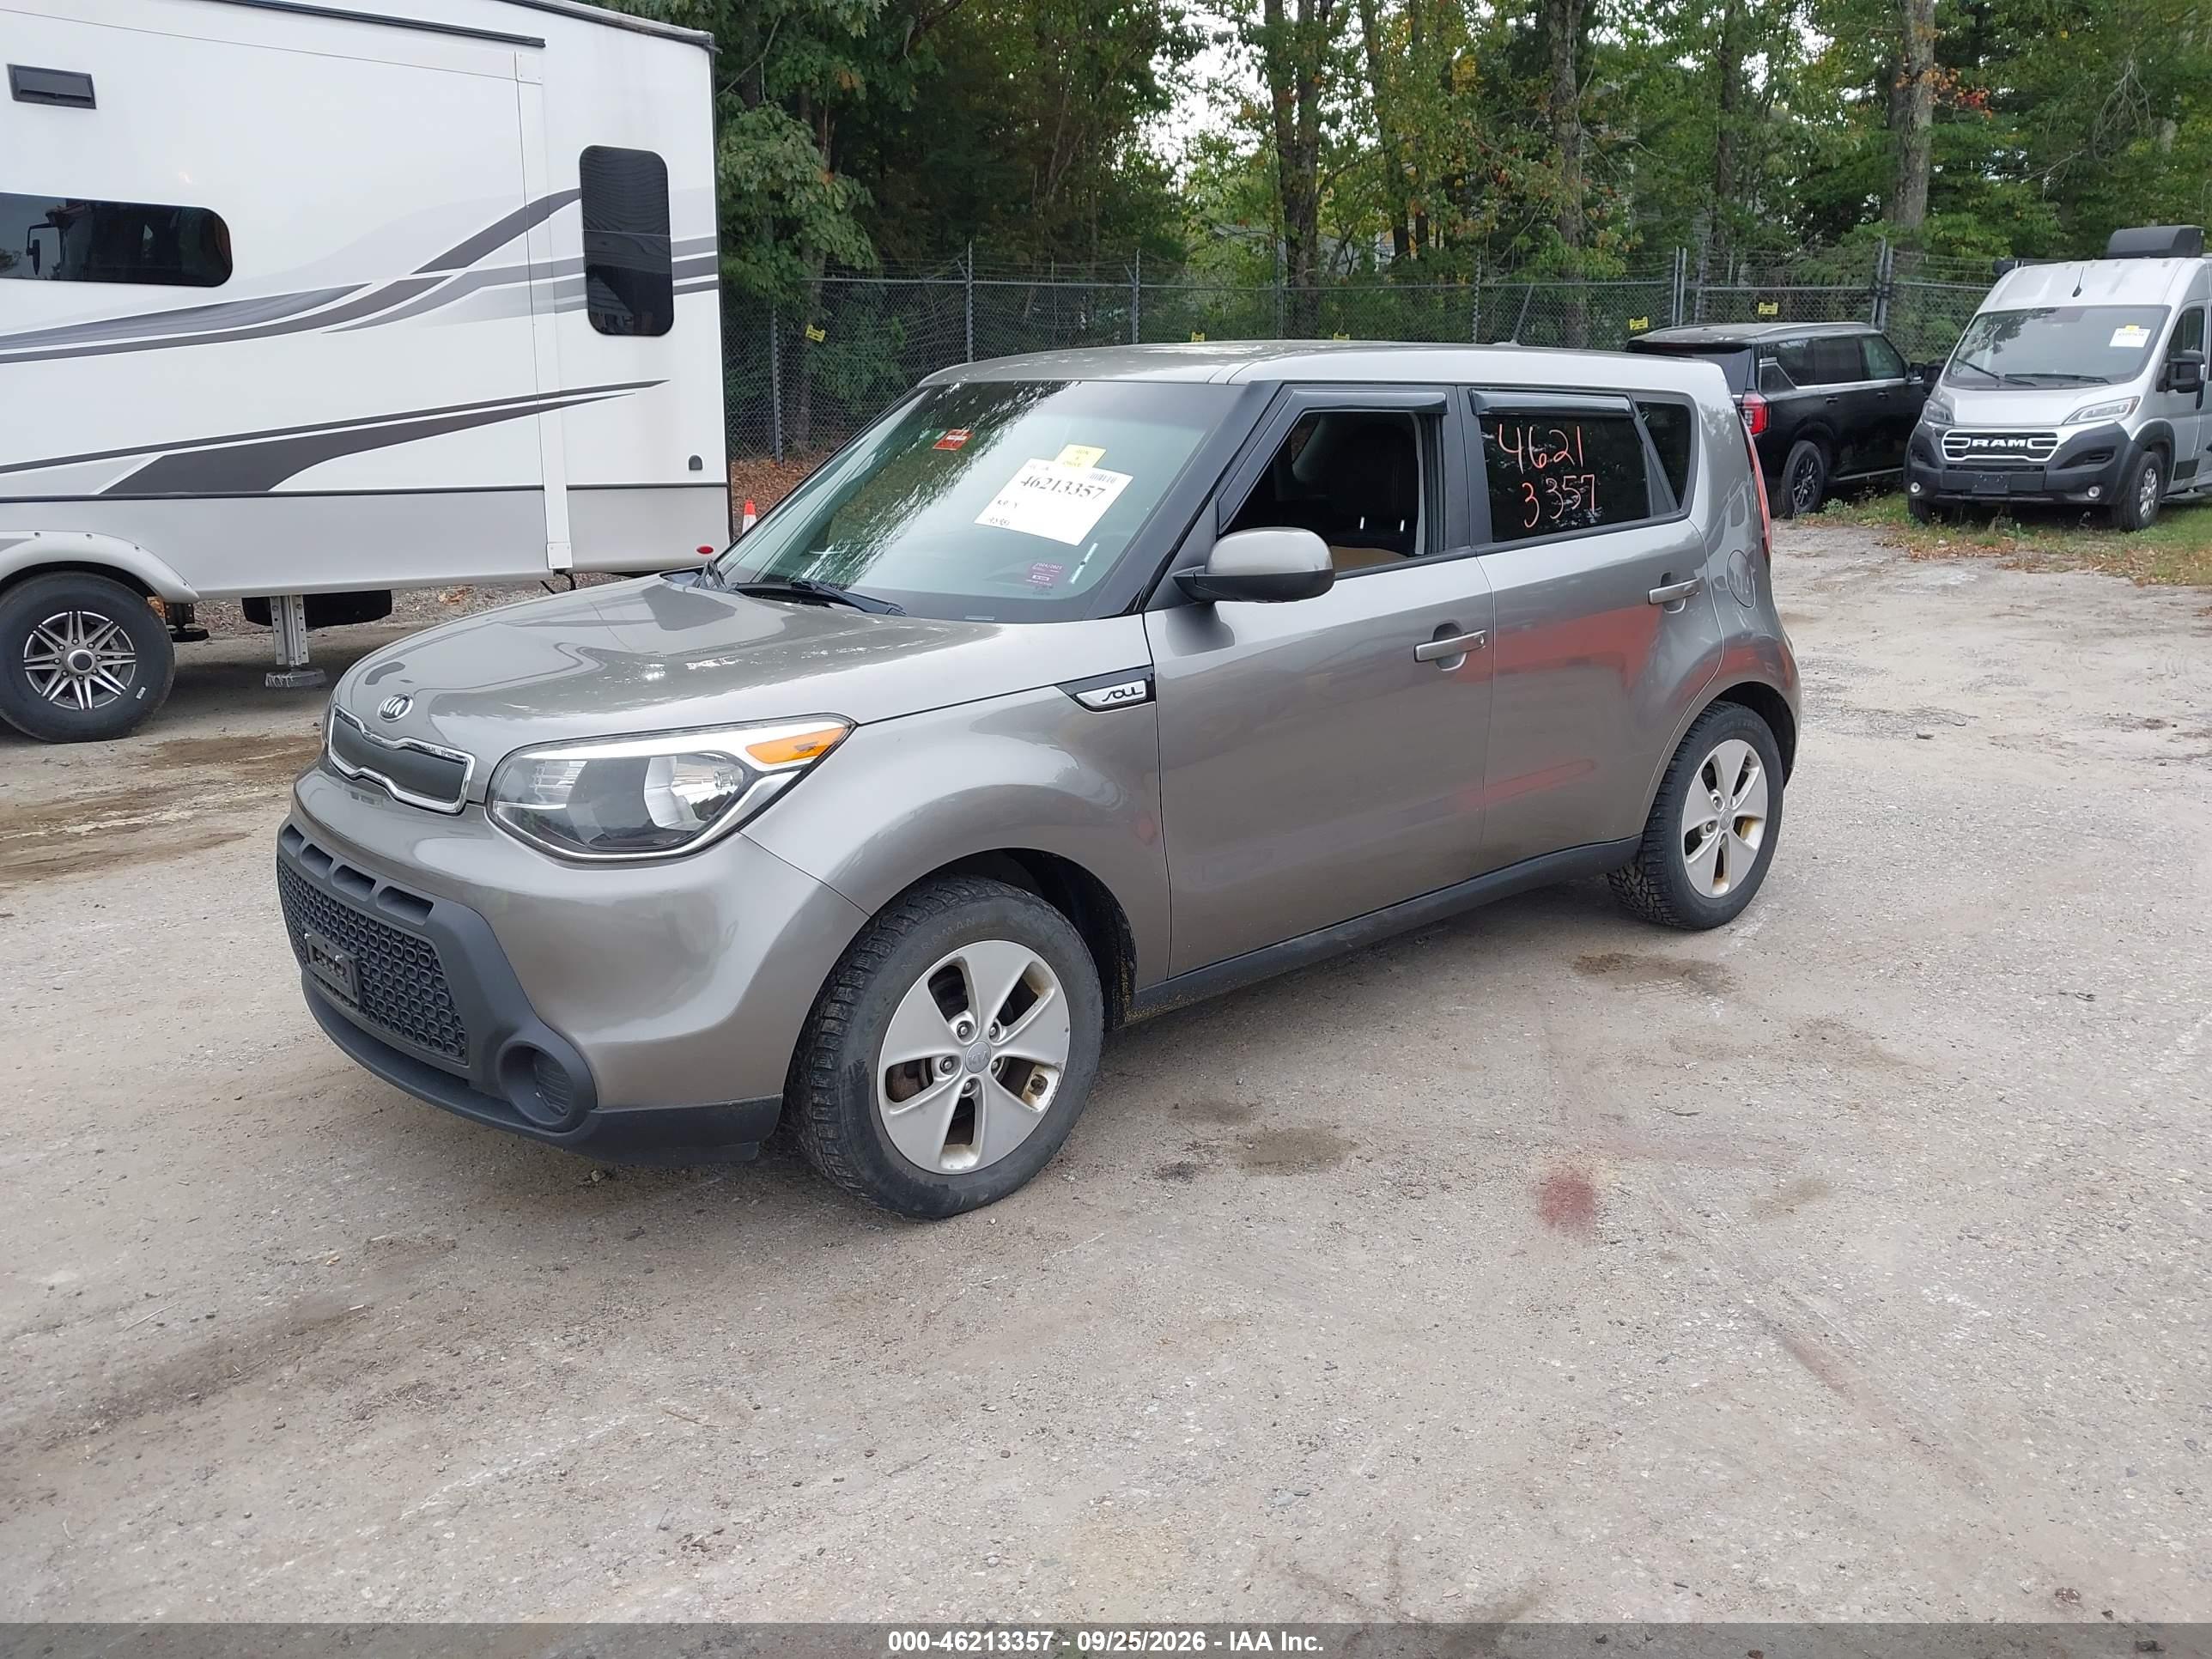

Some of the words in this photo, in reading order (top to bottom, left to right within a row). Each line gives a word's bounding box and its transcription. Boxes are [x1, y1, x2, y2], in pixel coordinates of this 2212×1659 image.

[1498, 423, 1583, 474] 4621
[1972, 438, 2027, 447] RAM
[1020, 475, 1106, 501] 46213357
[1102, 686, 1144, 702] SOUL
[380, 695, 409, 718] KIA
